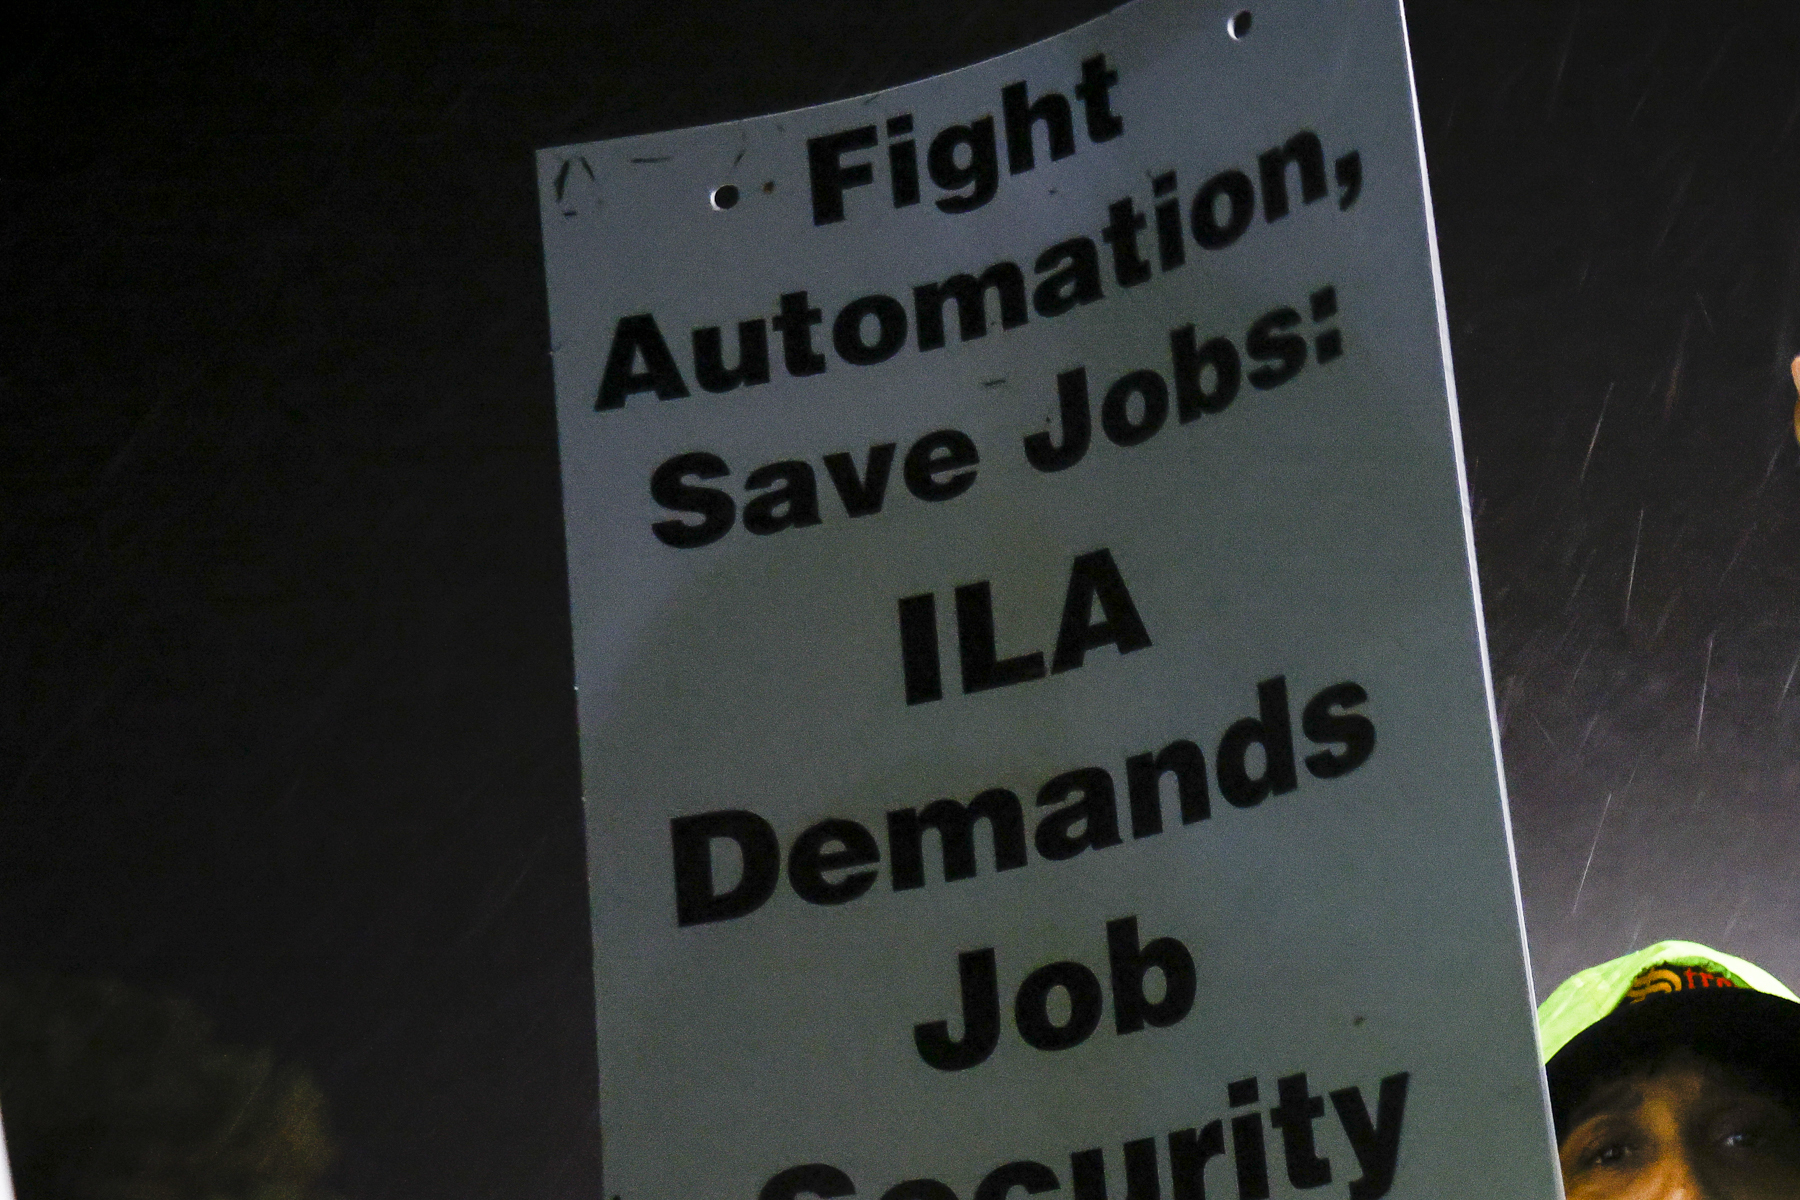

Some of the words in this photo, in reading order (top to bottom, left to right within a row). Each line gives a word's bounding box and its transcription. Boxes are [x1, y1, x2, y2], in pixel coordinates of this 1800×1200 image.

[806, 53, 1124, 227] Fight
[594, 130, 1363, 413] Automation,
[650, 429, 980, 549] Save
[1023, 286, 1343, 473] Jobs:
[898, 548, 1152, 706] ILA
[670, 675, 1376, 928] Demands
[914, 915, 1197, 1072] Job
